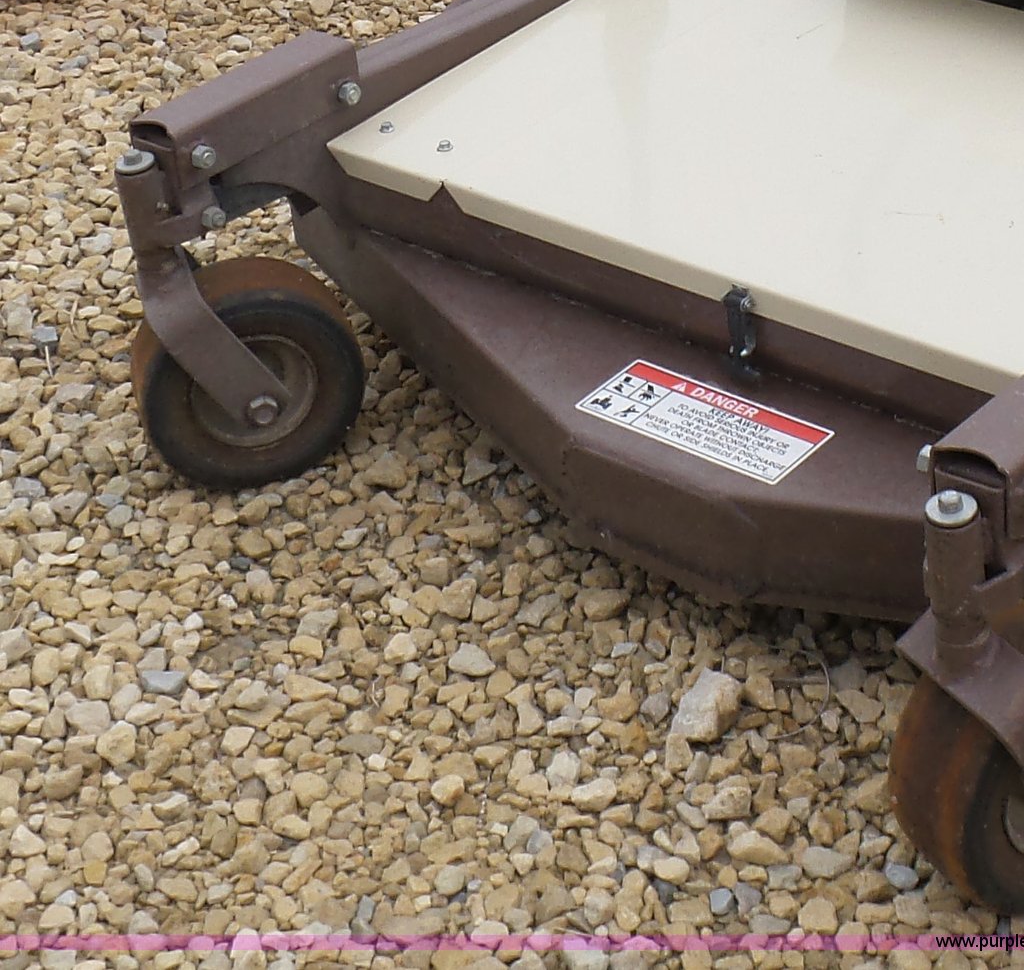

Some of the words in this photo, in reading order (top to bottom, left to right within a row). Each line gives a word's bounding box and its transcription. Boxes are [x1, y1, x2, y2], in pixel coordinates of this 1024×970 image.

[688, 386, 760, 418] DANGER
[707, 407, 736, 420] KEEP
[732, 416, 770, 433] AWAY!
[642, 412, 670, 425] NEVER
[667, 422, 704, 438] OPERATE
[701, 435, 738, 452] WITHOUT
[736, 449, 786, 470] DISCHARGE
[643, 420, 671, 433] CHUTE
[668, 430, 684, 438] OR
[682, 435, 702, 445] SIDE
[700, 442, 733, 457] SHIELDS
[730, 454, 744, 462] IN
[666, 406, 694, 419] DEATH
[691, 416, 718, 428] FROM
[715, 425, 752, 442] THROWN
[750, 439, 787, 455] OBJECTS
[679, 419, 694, 427] OR
[691, 424, 718, 436] BLADE
[687, 407, 715, 420] AVOID
[713, 417, 748, 433] SERIOUS
[746, 430, 776, 443] INJURY
[774, 440, 790, 449] OR
